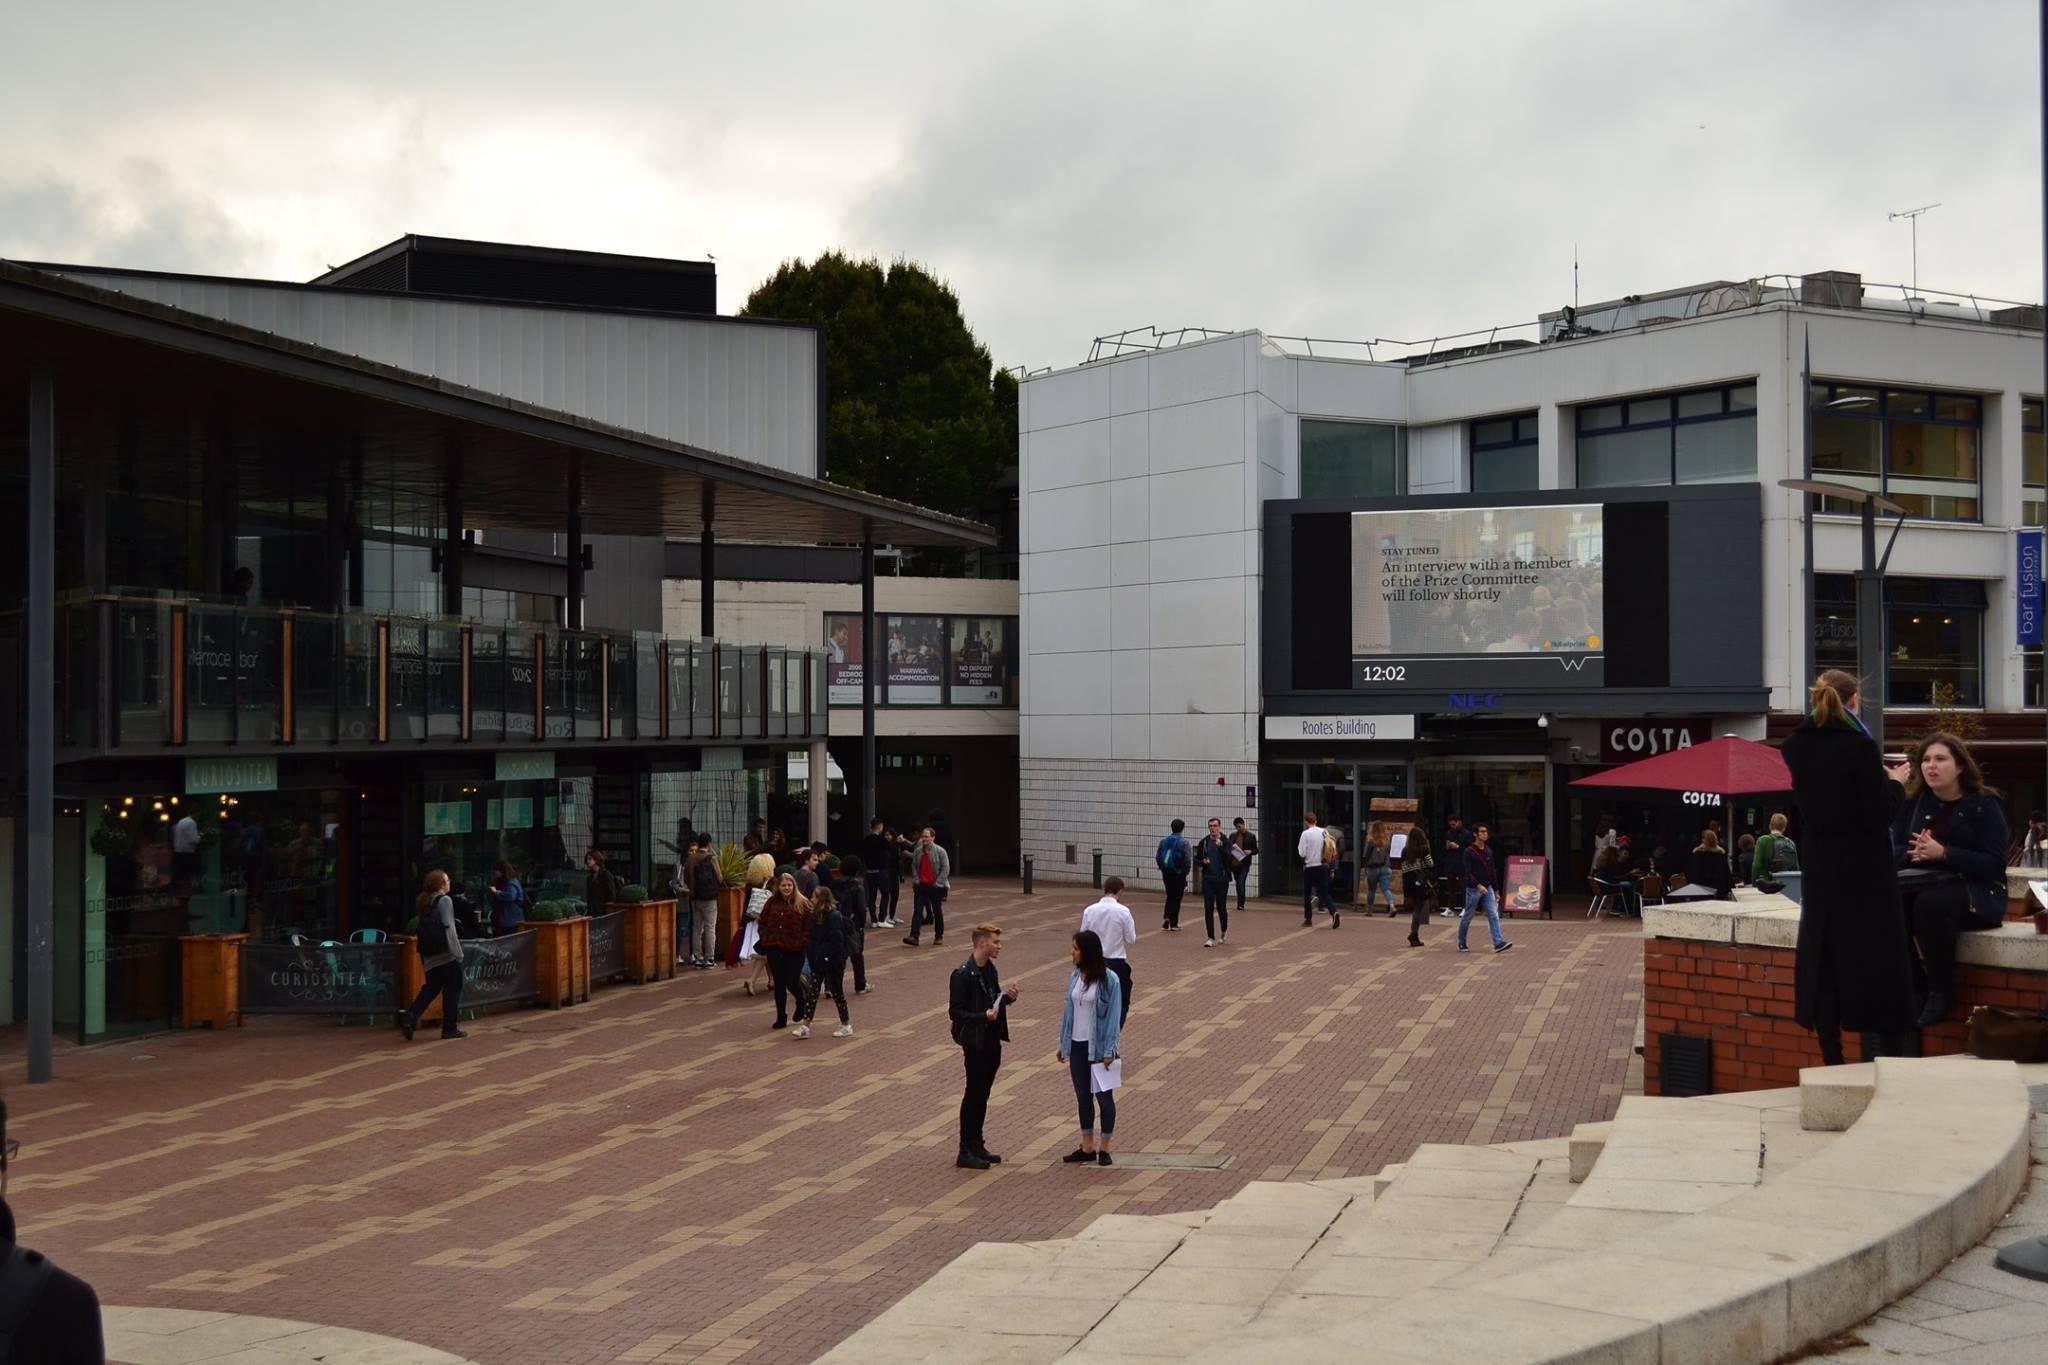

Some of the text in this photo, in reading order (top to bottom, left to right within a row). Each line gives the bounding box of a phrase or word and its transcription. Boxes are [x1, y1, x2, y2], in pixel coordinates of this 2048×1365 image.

[1382, 546, 1440, 557] STAY TUNED
[1382, 556, 1574, 573] An interview with a member
[1382, 572, 1540, 588] of the Prize Committee
[1382, 586, 1502, 603] will follow shortly
[2019, 545, 2040, 635] bar fusion
[1363, 665, 1406, 681] 12:02
[1448, 693, 1504, 711] NEC
[1302, 718, 1376, 741] Rootes Building
[1610, 728, 1692, 755] COSTA
[192, 763, 272, 787] CURIOSITEA
[1682, 791, 1721, 807] COSTA
[271, 971, 366, 987] CURIOSITEA
